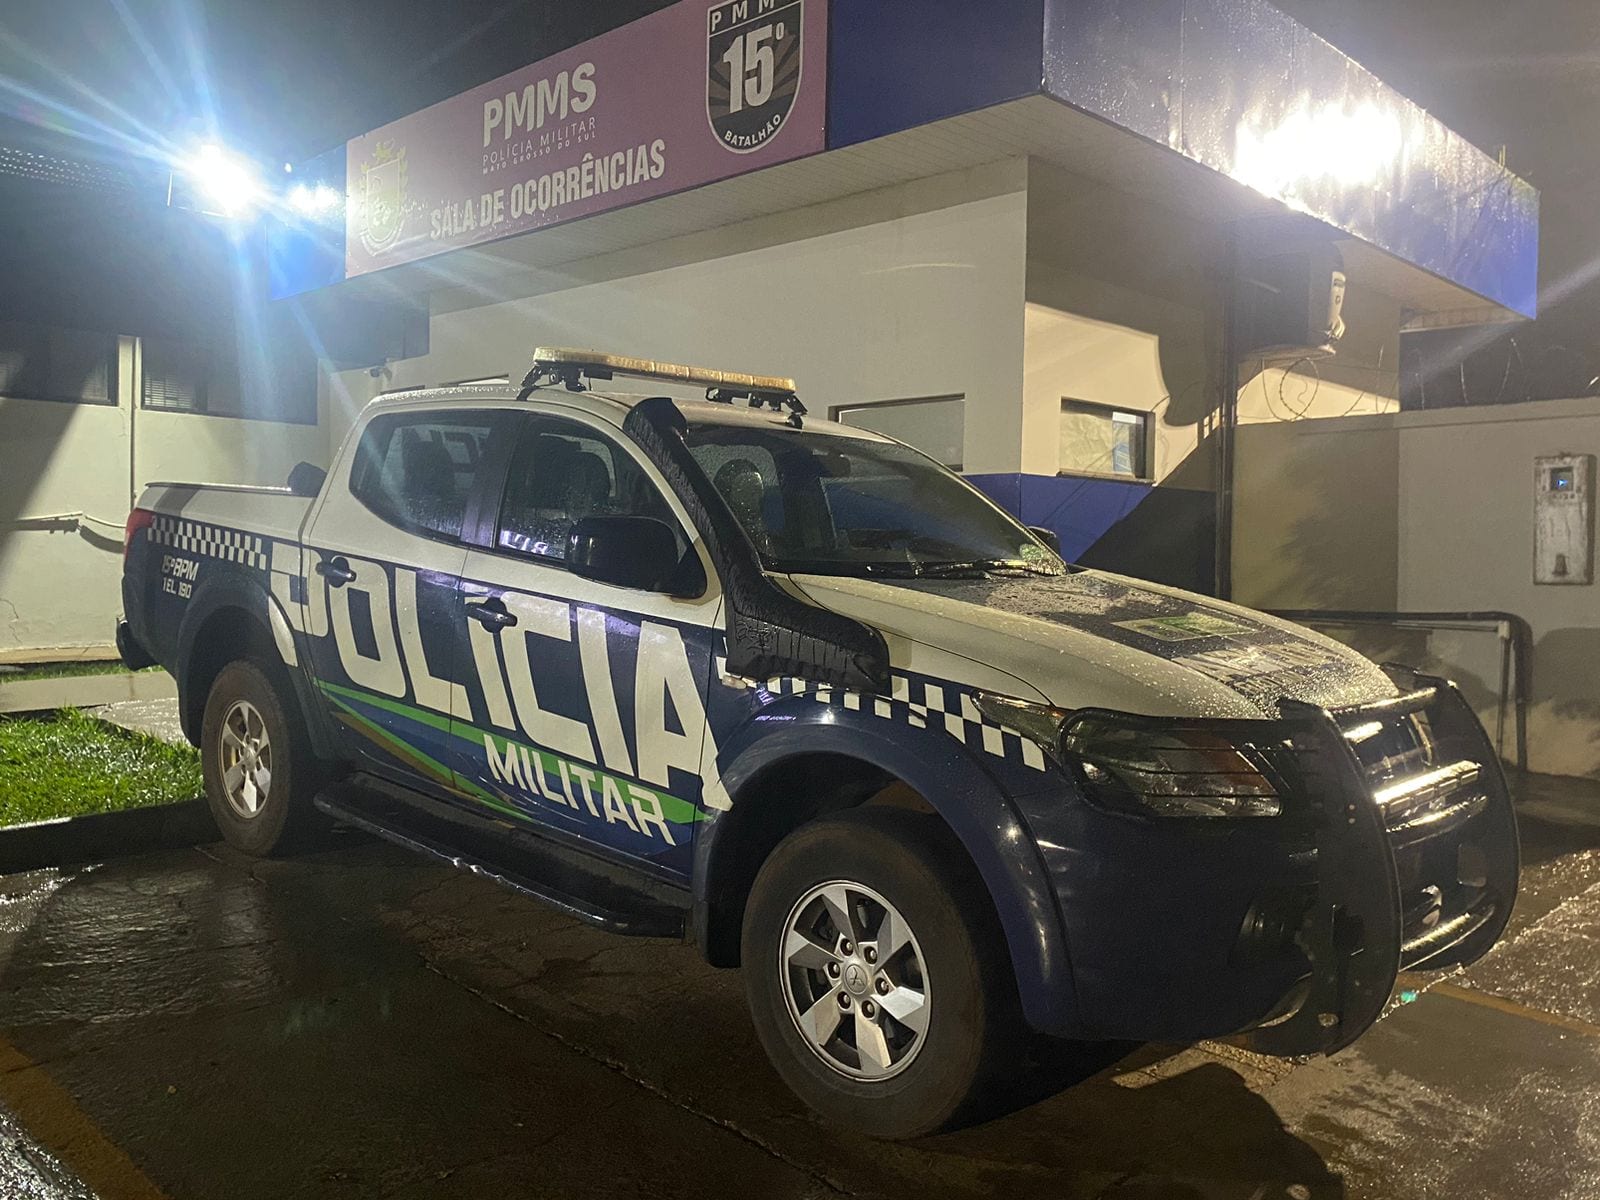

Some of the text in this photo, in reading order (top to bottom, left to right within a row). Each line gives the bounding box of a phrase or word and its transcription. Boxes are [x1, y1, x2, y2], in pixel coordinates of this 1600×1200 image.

[483, 62, 597, 148] PMMS
[482, 130, 596, 175] MATO GROSSO DO SUL
[540, 116, 596, 147] MILITAR
[724, 114, 781, 147] BATALHÃO
[430, 138, 666, 240] SALA DE OCORRÊNCIAS
[178, 581, 192, 599] 190
[483, 733, 677, 847] MILITAR
